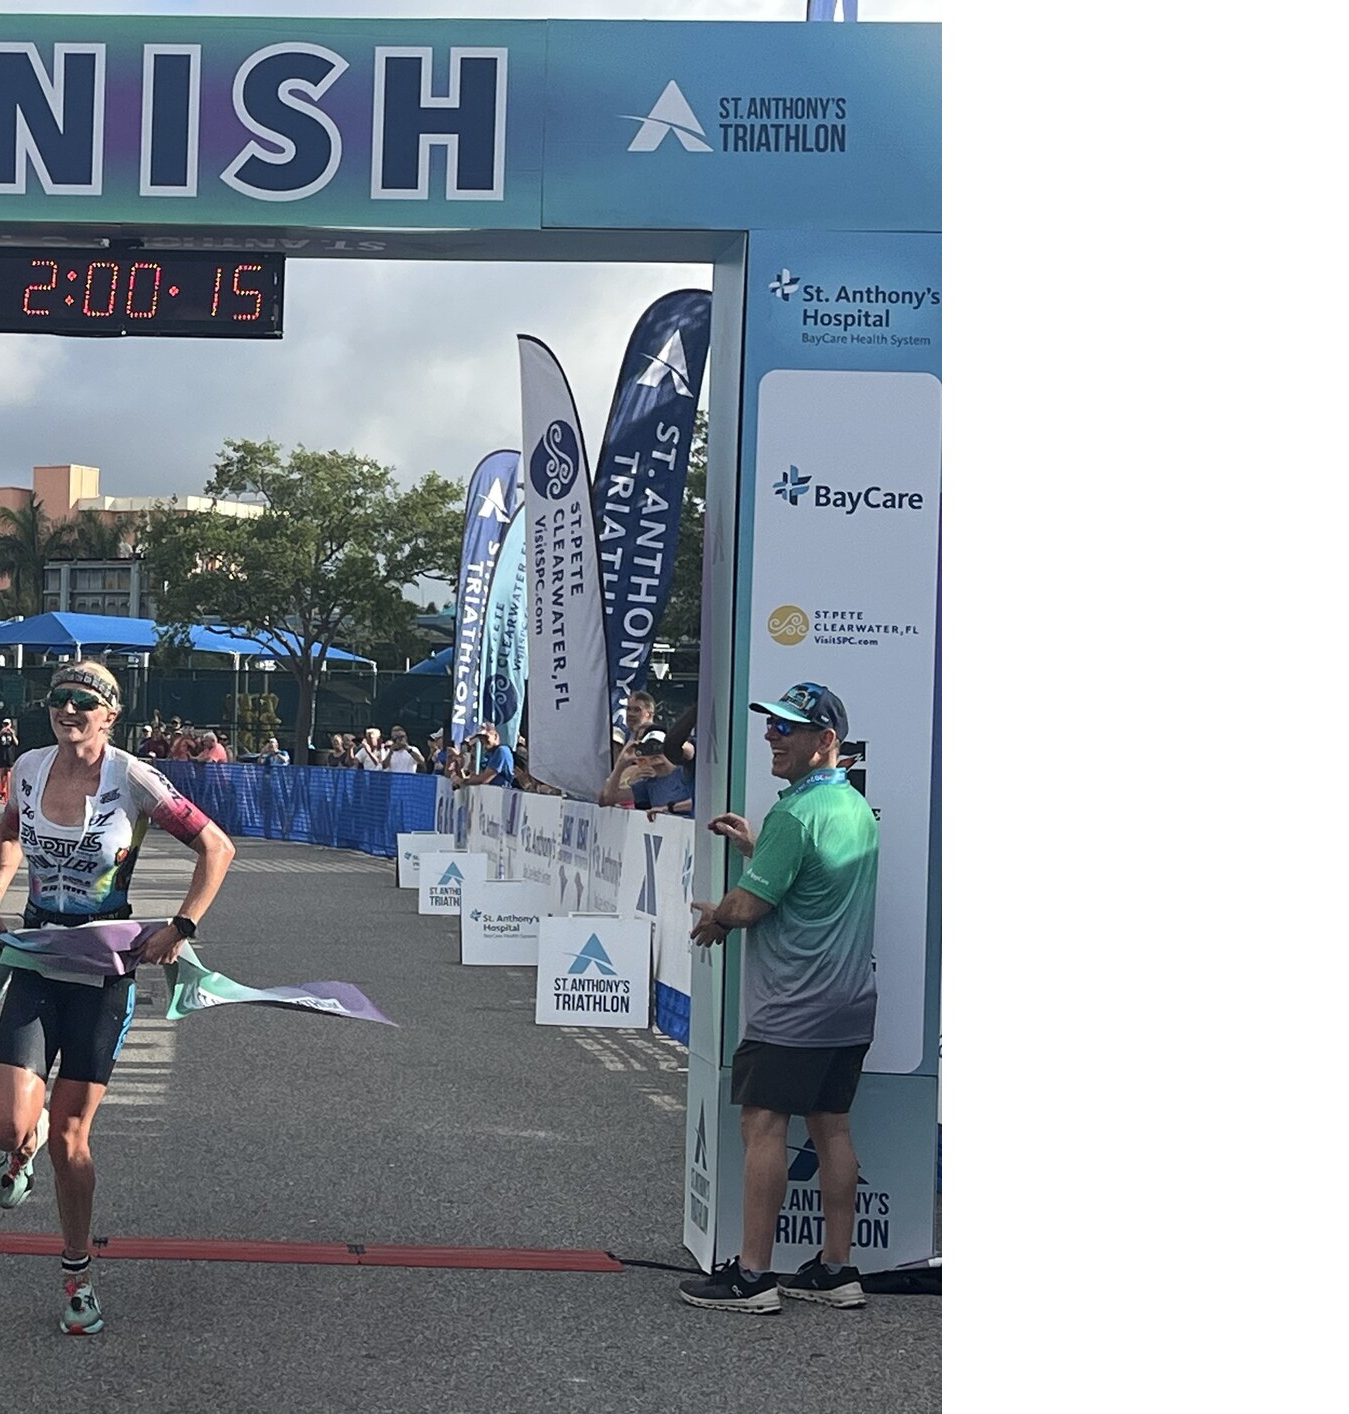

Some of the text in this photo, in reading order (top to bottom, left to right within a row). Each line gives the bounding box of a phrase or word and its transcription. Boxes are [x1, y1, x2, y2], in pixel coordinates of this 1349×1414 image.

[719, 97, 846, 119] ST. ANTHONY'S
[719, 124, 846, 152] TRIATHLON
[803, 285, 941, 310] St. Anthony's
[803, 309, 889, 331] Hospital
[802, 333, 931, 347] BayCare Health System
[648, 421, 680, 478] ST.
[815, 485, 923, 514] BayCare
[535, 515, 546, 635] VisitSPC.com
[452, 561, 484, 725] TRIATHLON
[814, 636, 878, 646] VisitSPC.com
[429, 895, 460, 906] TRIATH
[439, 887, 461, 895] ANTHO
[483, 924, 520, 933] Hospital
[497, 914, 540, 924] Anthony's
[554, 977, 630, 994] ST. ANTHONY'S
[554, 993, 630, 1013] TRIATHLON
